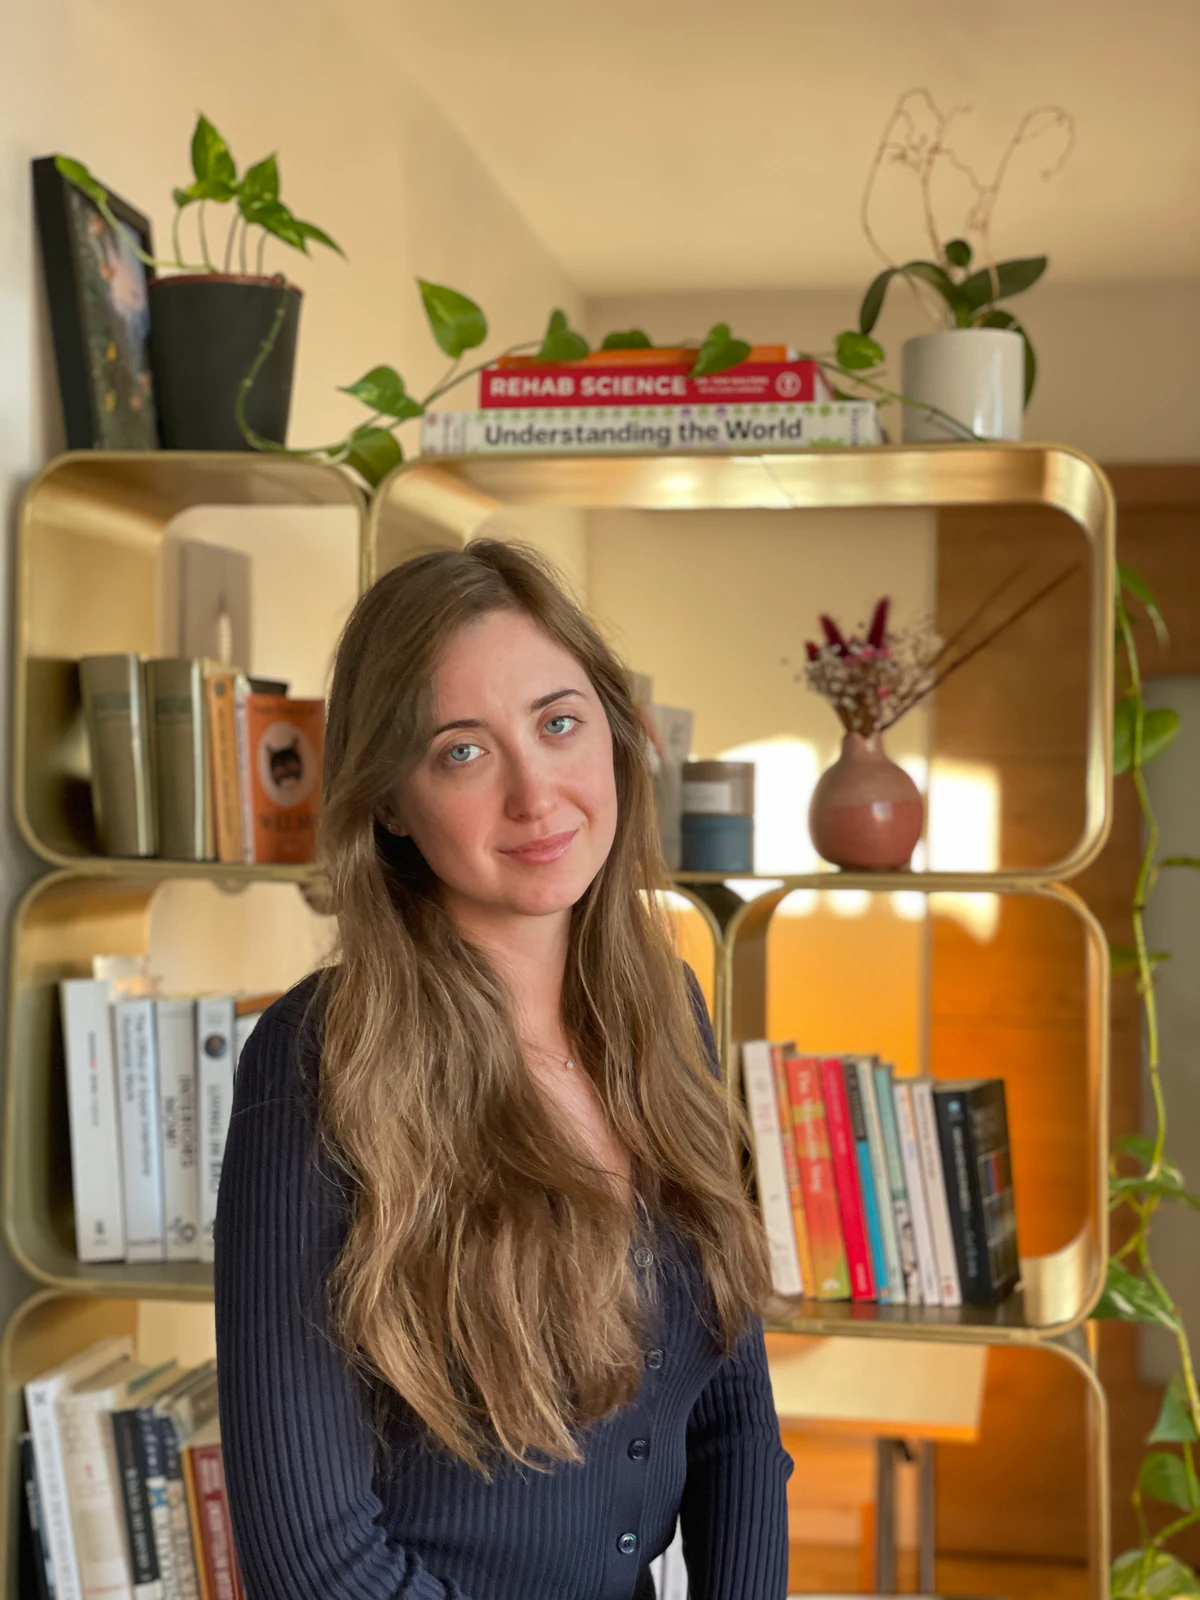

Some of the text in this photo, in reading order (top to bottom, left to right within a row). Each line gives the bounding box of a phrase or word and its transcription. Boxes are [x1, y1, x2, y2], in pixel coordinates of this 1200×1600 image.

[489, 376, 575, 397] REHAB
[580, 374, 687, 397] SCIENCE
[484, 418, 802, 448] Understanding the World
